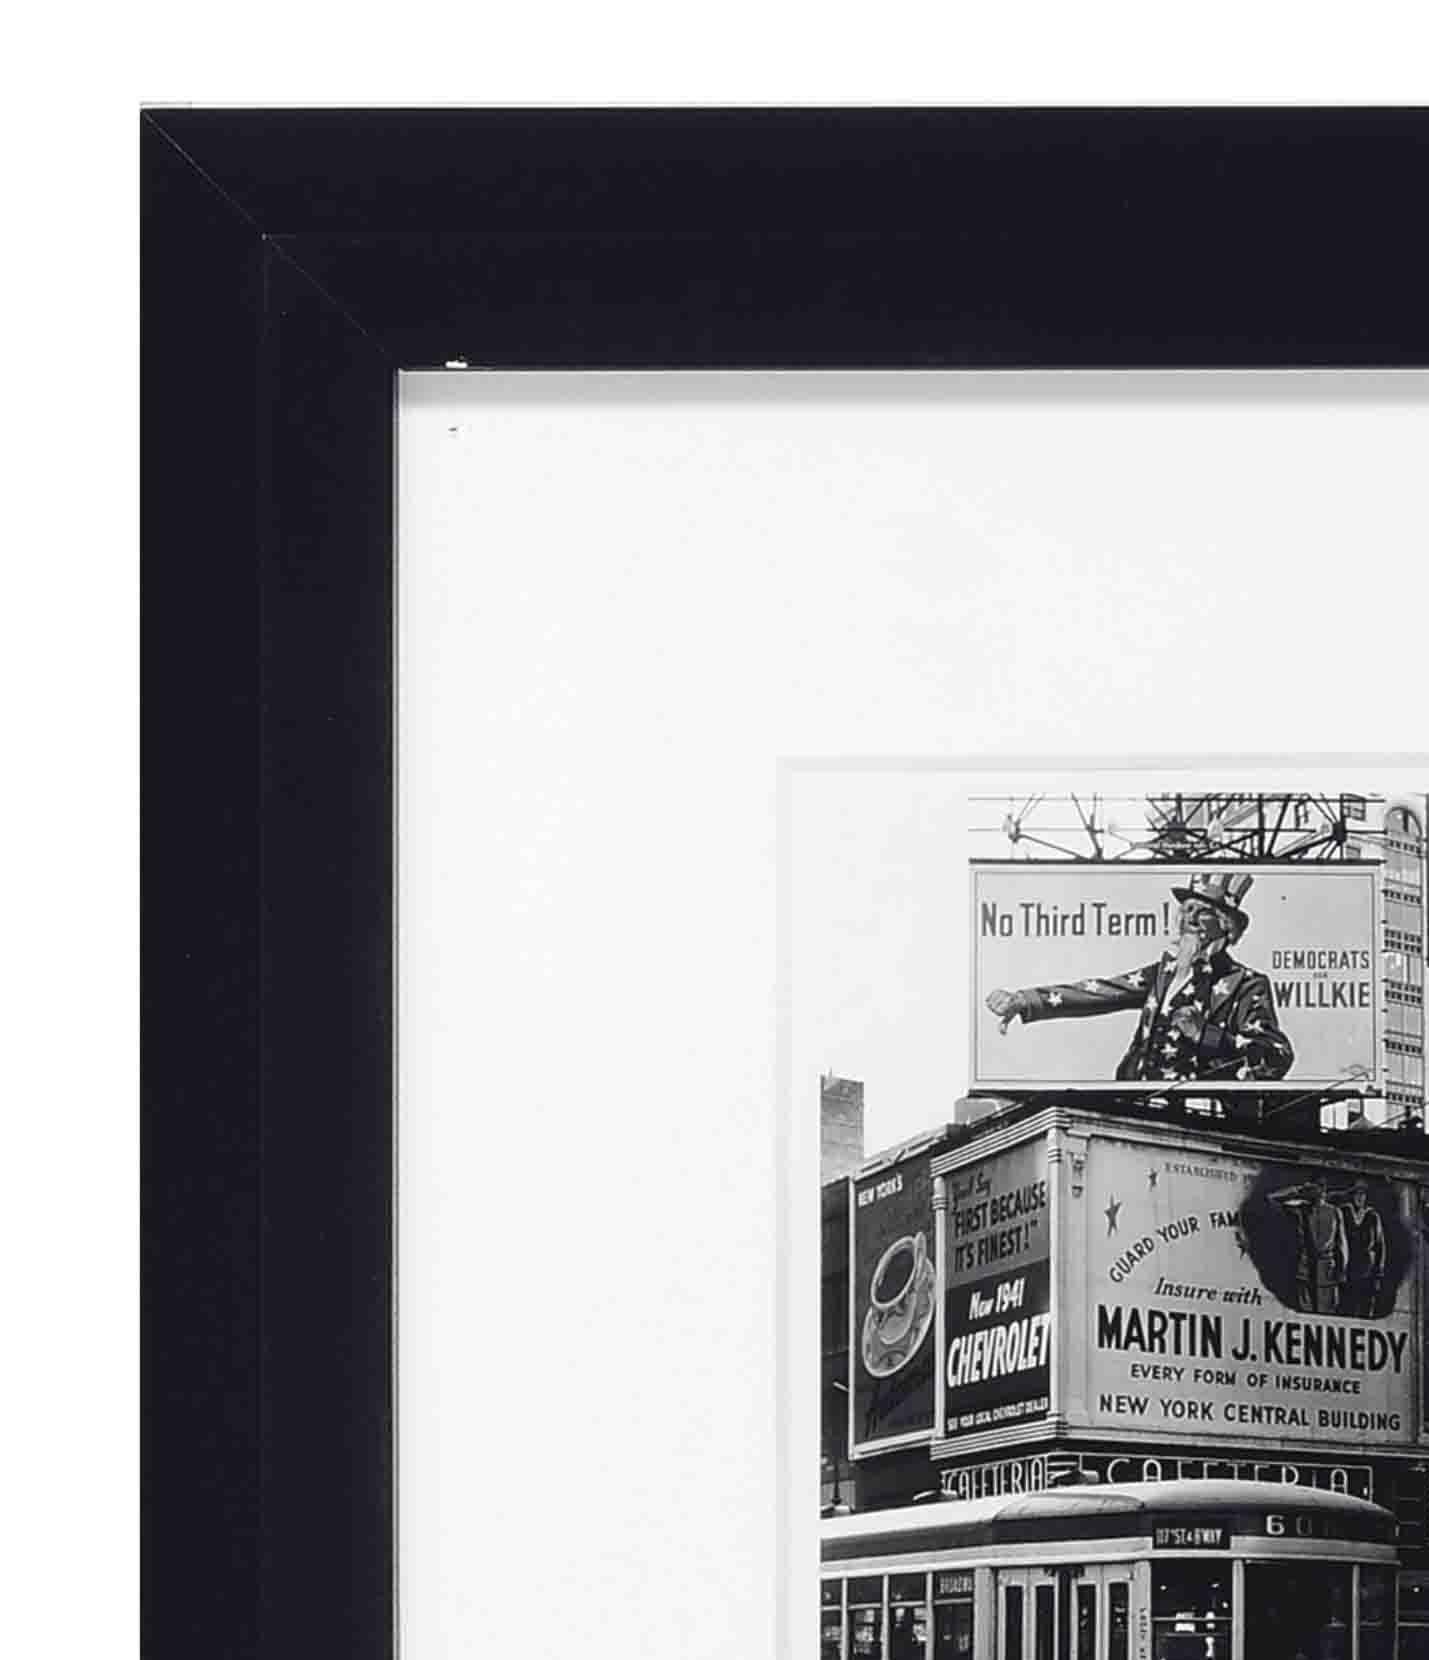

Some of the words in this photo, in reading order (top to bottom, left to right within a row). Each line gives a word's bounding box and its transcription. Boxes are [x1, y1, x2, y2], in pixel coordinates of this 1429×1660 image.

[981, 902, 1013, 937] No
[1020, 902, 1085, 937] Third
[1271, 950, 1370, 970] DEMOCRATS
[1273, 982, 1371, 1009] WILLKIE
[990, 1179, 1046, 1227] BECAUSE
[1108, 1236, 1155, 1284] GUARD
[1156, 1214, 1200, 1245] YOUR
[1209, 1210, 1241, 1231] FAM
[995, 1277, 1025, 1314] 1941
[1154, 1276, 1218, 1301] Insure
[1222, 1286, 1263, 1307] with
[947, 1311, 1051, 1388] CHEVROLET
[1097, 1303, 1223, 1360] MARTIN
[1231, 1317, 1258, 1363] J.
[1263, 1319, 1408, 1374] KENNEDY
[1130, 1363, 1185, 1382] EVERY
[1193, 1369, 1237, 1386] FORM
[1246, 1373, 1269, 1389] OF
[1275, 1375, 1361, 1395] INSURANCE
[1099, 1393, 1149, 1415] NEW
[1159, 1399, 1214, 1421] YORK
[1223, 1403, 1310, 1427] CENTRAL
[1318, 1409, 1402, 1431] BUILDING
